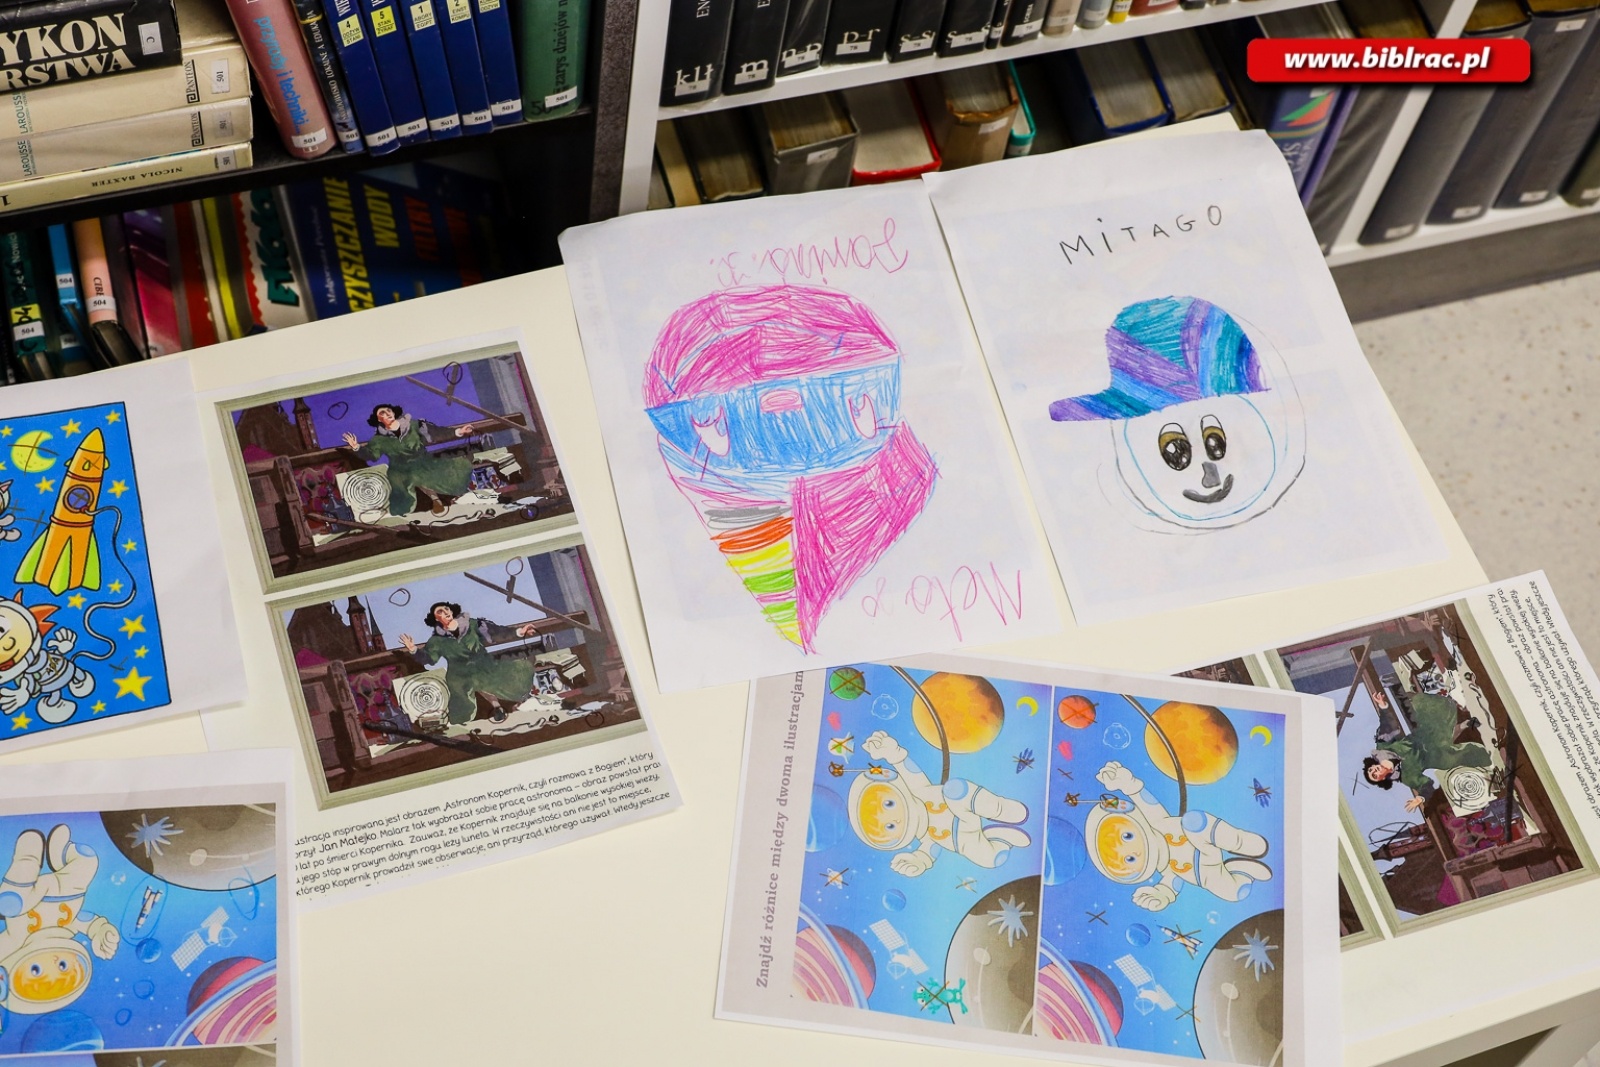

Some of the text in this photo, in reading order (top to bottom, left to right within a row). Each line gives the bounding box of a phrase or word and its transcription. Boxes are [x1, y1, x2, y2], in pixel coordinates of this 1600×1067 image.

[379, 11, 386, 20] 5
[418, 5, 424, 14] 1
[253, 15, 288, 70] przyrody
[552, 20, 568, 89] zarys dziejów
[216, 70, 225, 82] 501
[17, 92, 30, 135] LAROUSS
[501, 103, 515, 112] 501
[555, 94, 569, 103] 501
[407, 123, 421, 132] 501
[474, 114, 488, 123] 501
[303, 136, 317, 144] 501
[377, 133, 391, 142] 501
[17, 139, 32, 177] LAROUSSE
[91, 167, 183, 188] NICOLA BAXTER
[363, 184, 400, 248] WODY
[59, 277, 73, 285] 504
[92, 298, 107, 307] 504
[21, 327, 35, 335] 504
[1487, 593, 1500, 615] który
[1505, 603, 1522, 632] powstał
[1517, 634, 1533, 655] obraz
[1514, 648, 1535, 683] rozmowa
[1532, 661, 1557, 700] astronoma
[1548, 669, 1558, 680] na
[1559, 691, 1580, 722] znajduje
[1564, 723, 1578, 743] sobie
[1575, 722, 1597, 756] Kopernik
[332, 818, 386, 839] inspirowana
[383, 813, 402, 830] jest
[402, 804, 441, 821] obrazem
[487, 783, 528, 801] Kopernik,
[528, 777, 548, 793] czyli
[548, 769, 587, 785] rozmowa
[629, 750, 654, 764] który
[777, 754, 794, 807] dwoma
[1575, 771, 1596, 805] obrazem
[318, 843, 339, 854] Jan
[379, 825, 411, 839] Malarz
[411, 819, 427, 831] tak
[475, 803, 498, 817] sobie
[499, 796, 526, 813] pracę
[526, 785, 574, 803] astronoma
[581, 776, 608, 790] obraz
[608, 765, 643, 783] powstał
[299, 860, 312, 871] lat
[312, 858, 325, 869] po
[326, 849, 359, 865] śmierci
[459, 815, 499, 833] Kopernik
[499, 805, 537, 822] znajduje
[538, 801, 551, 814] się
[551, 799, 564, 809] na
[564, 788, 599, 805] balkonie
[599, 781, 635, 797] wysokiej
[301, 871, 321, 887] jego
[322, 863, 343, 878] stóp
[343, 864, 351, 872] w
[351, 855, 388, 874] prawym
[388, 847, 419, 864] dolnym
[420, 842, 442, 856] rogu
[491, 825, 501, 836] W
[500, 812, 562, 835] rzeczywistości
[562, 806, 578, 818] ani
[577, 803, 592, 814] nie
[590, 798, 607, 813] jest
[608, 795, 618, 805] to
[332, 872, 372, 890] Kopernik
[372, 862, 416, 881] prowadził
[416, 857, 435, 868] swe
[487, 839, 502, 850] ani
[545, 820, 579, 837] którego
[613, 803, 640, 818] Wtedy
[638, 791, 670, 808] jeszcze
[772, 813, 789, 869] między
[762, 871, 779, 933] różnice
[755, 934, 774, 989] Znajdź
